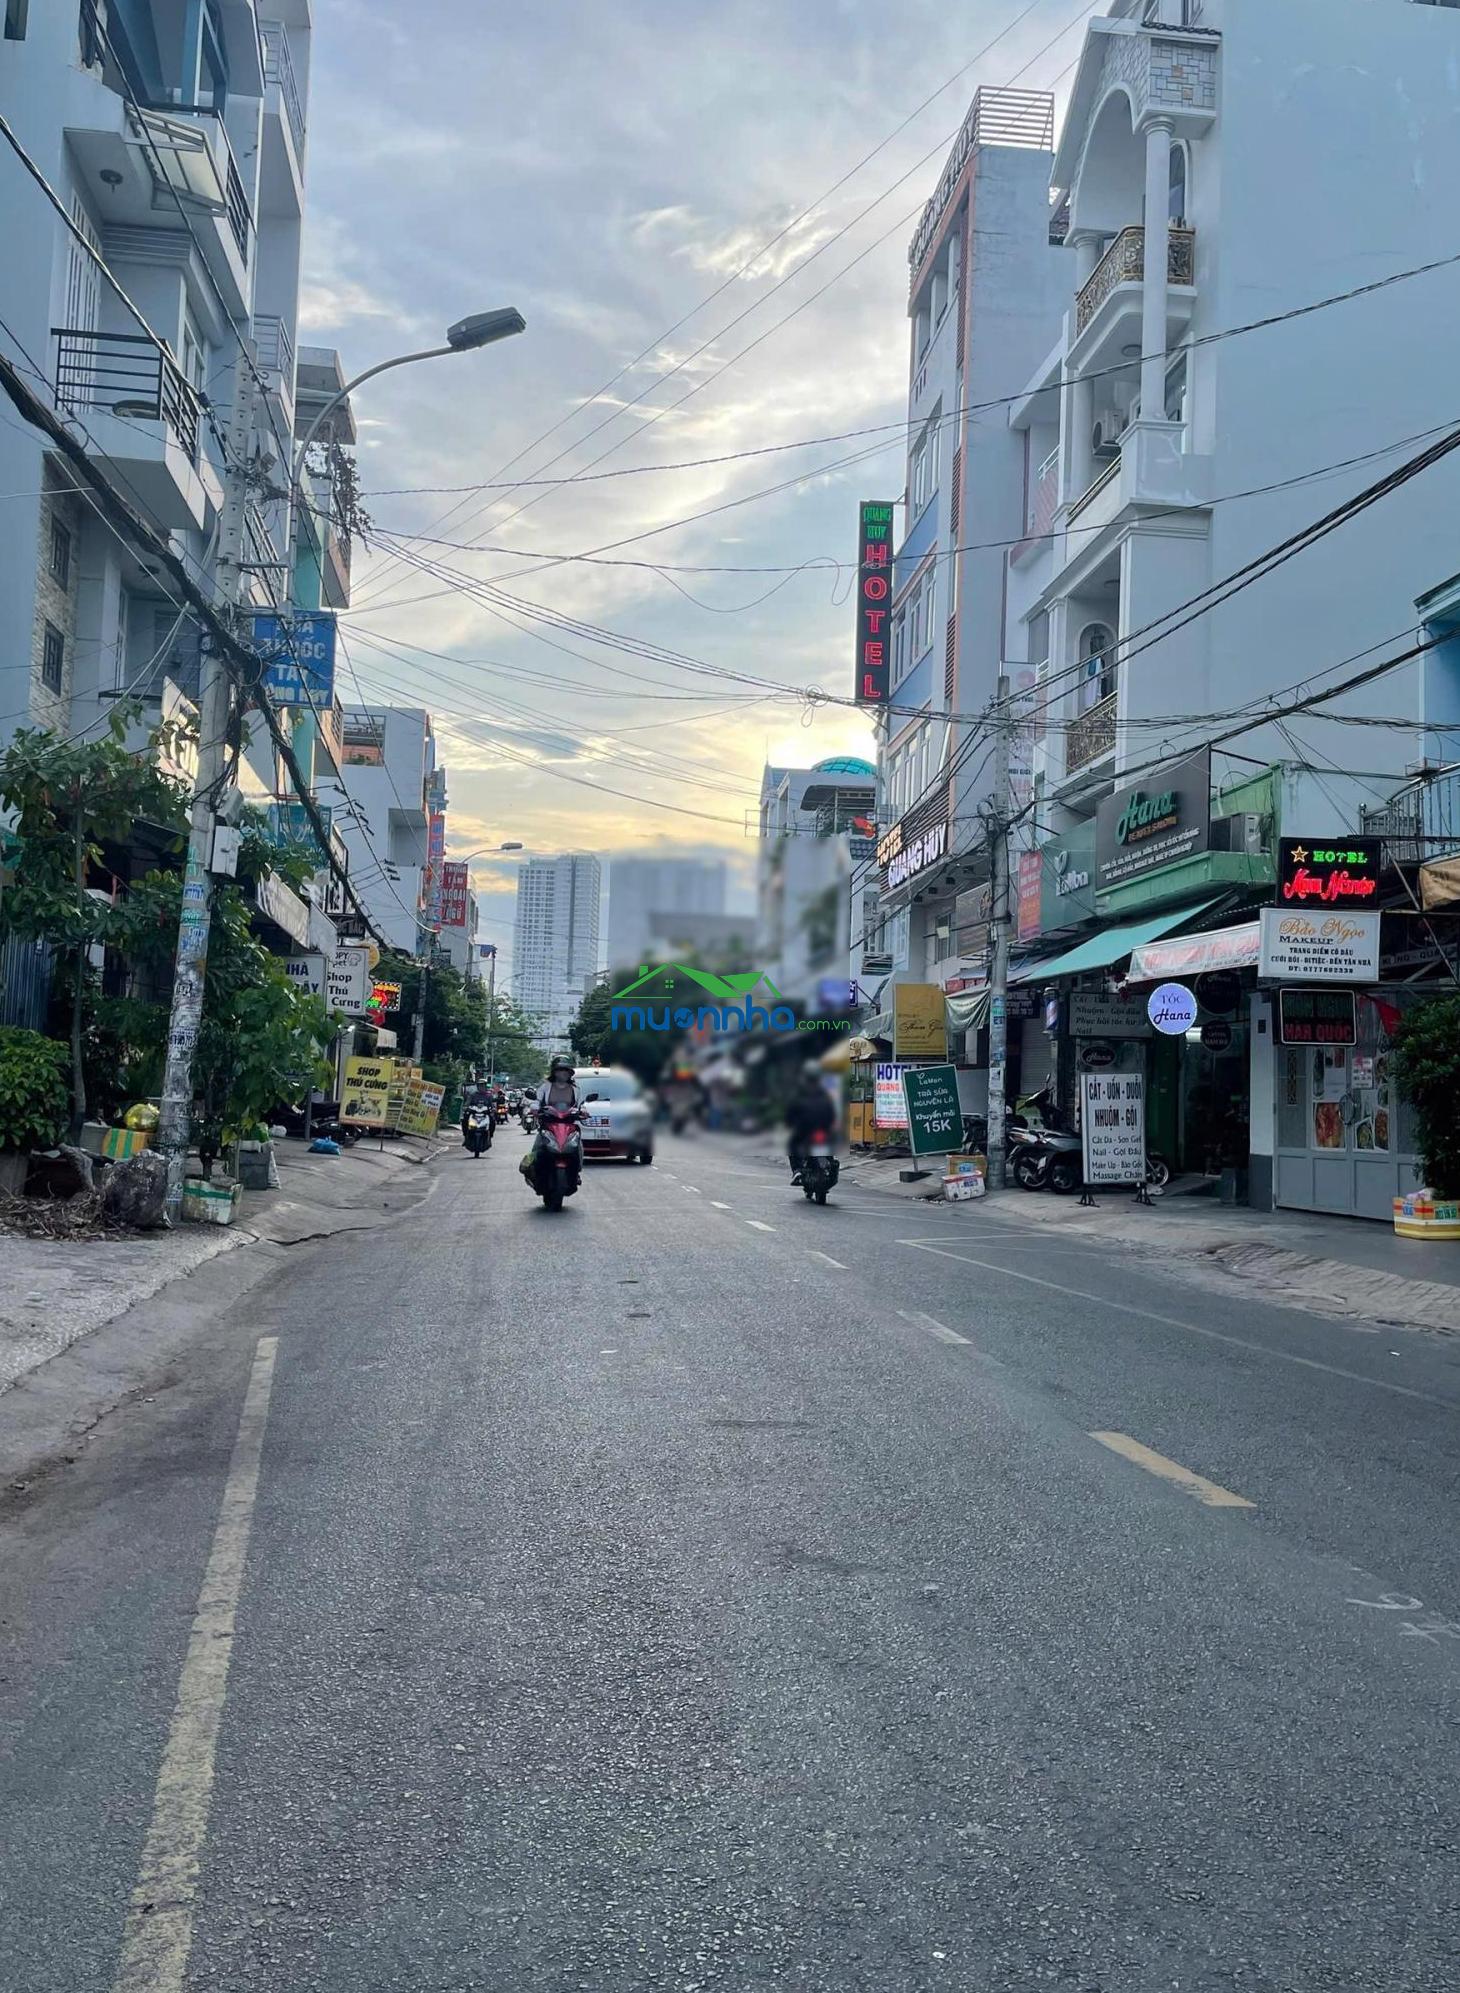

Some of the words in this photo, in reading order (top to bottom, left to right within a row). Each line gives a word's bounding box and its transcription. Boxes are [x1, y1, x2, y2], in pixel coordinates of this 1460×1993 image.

[863, 544, 887, 698] HOTEL
[1312, 850, 1368, 863] HOTEL
[1153, 1009, 1191, 1025] Hana
[357, 1066, 380, 1077] SHOP
[923, 1119, 952, 1134] 15K
